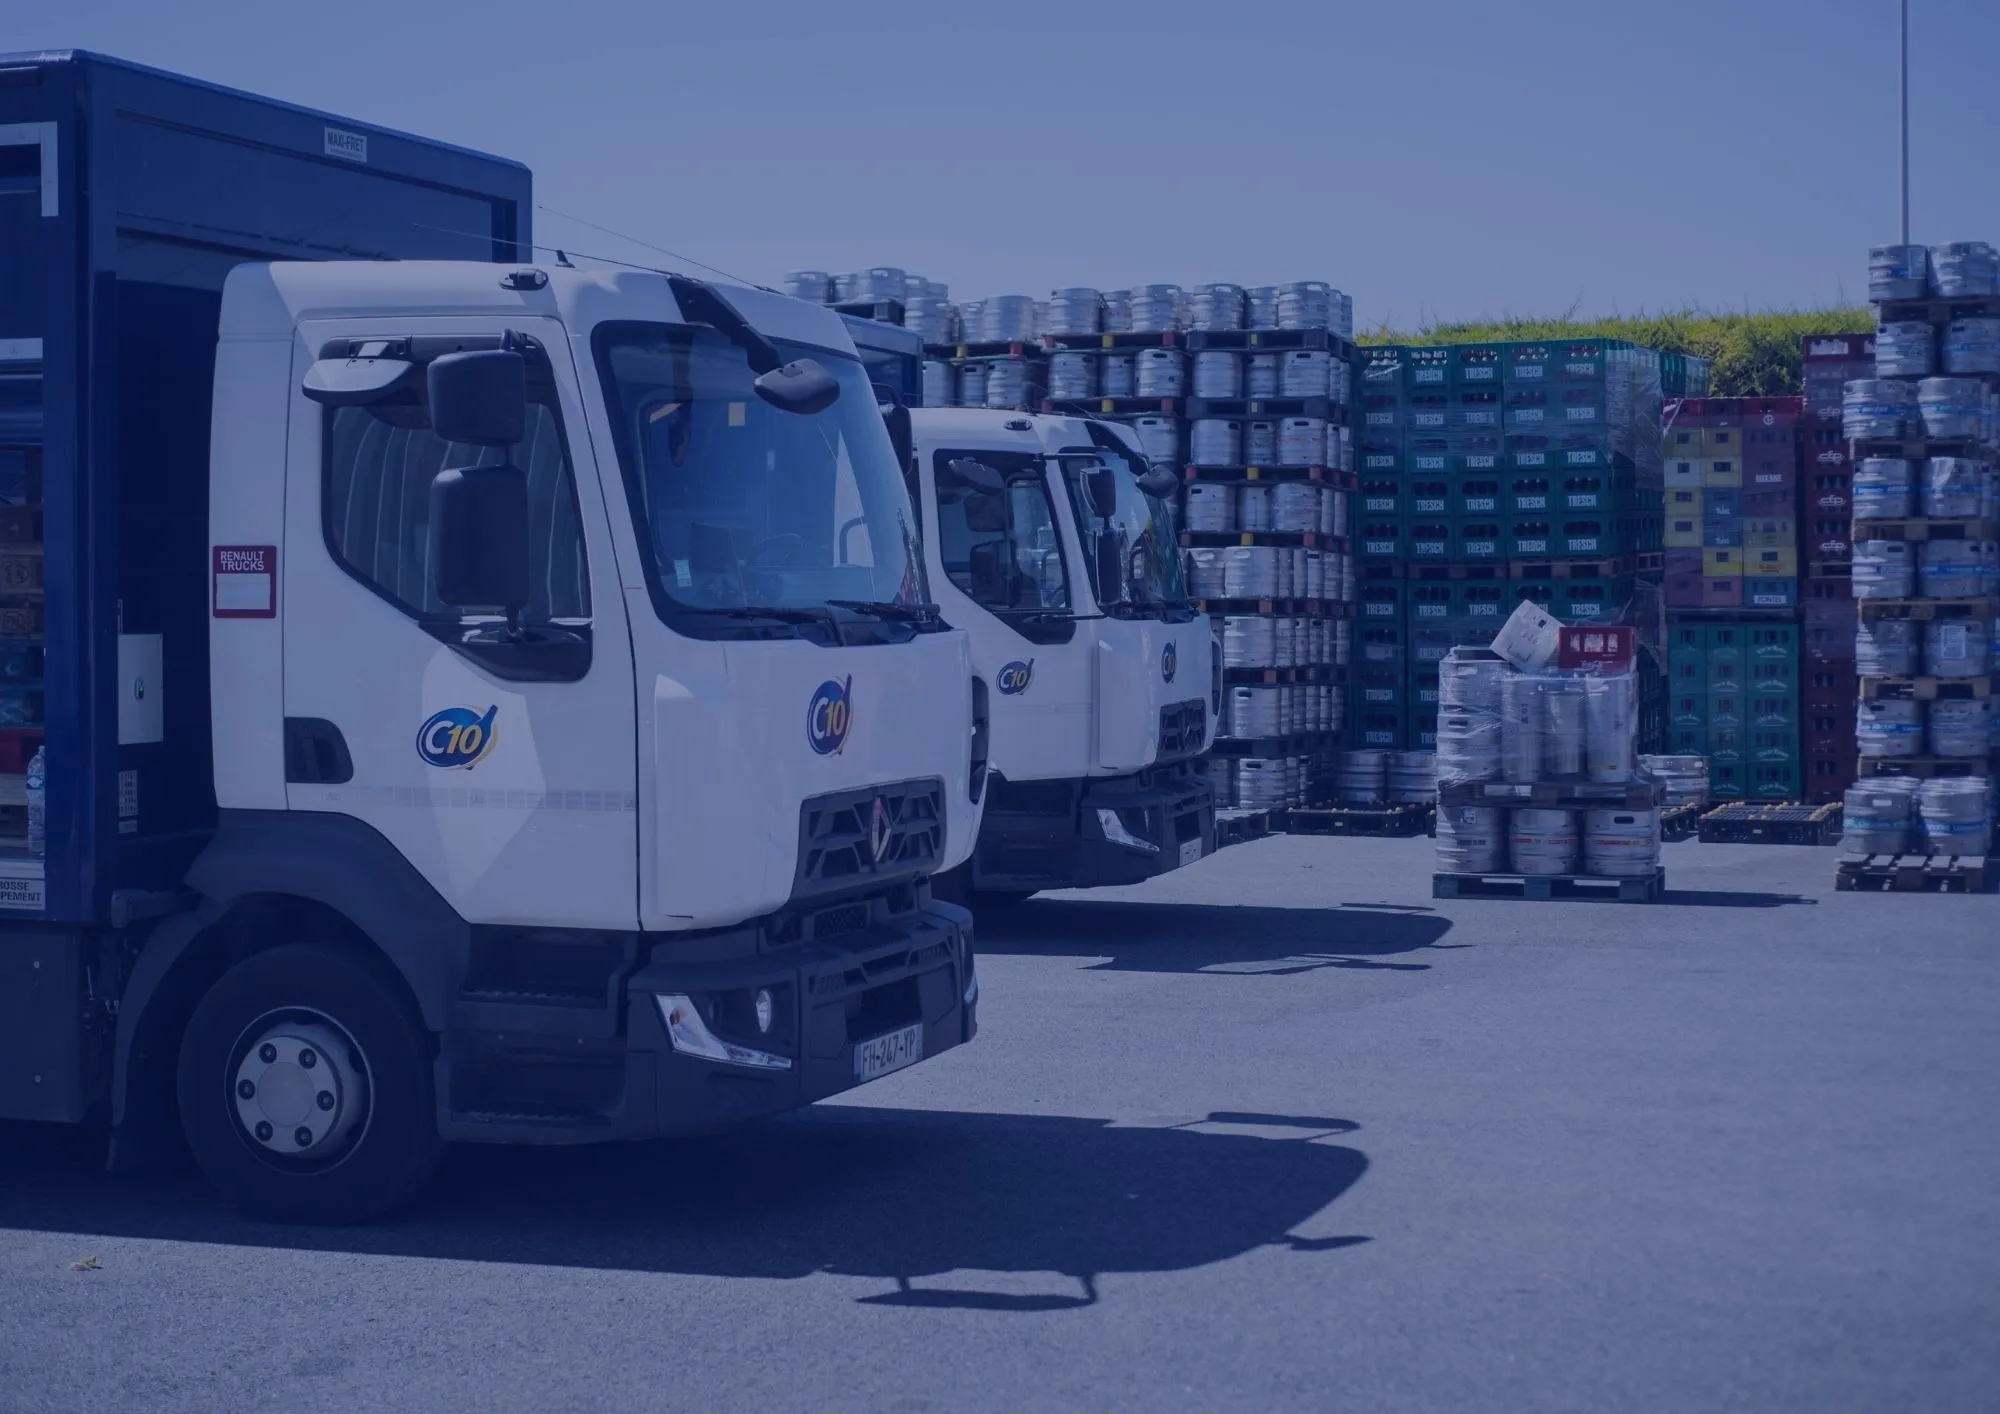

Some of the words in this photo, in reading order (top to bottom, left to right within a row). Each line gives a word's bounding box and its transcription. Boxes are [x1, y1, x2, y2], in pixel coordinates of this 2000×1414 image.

[328, 131, 364, 152] MAXI-FRET
[1465, 367, 1494, 379] TRESCH
[1515, 366, 1543, 378] TRESCH
[1565, 363, 1594, 375] TRESCH
[1416, 414, 1444, 425] TRESCH
[1515, 409, 1543, 422] TRESCH
[1566, 407, 1595, 420] TRESCH
[1366, 455, 1394, 467] TRESCH
[1416, 457, 1444, 468] TRESCH
[1466, 456, 1494, 468] TRESCH
[1516, 452, 1545, 465] TRESCH
[1567, 451, 1596, 463] TRESCH
[1366, 499, 1394, 510] TRESCH
[1416, 500, 1444, 511] TRESCH
[1466, 499, 1494, 510] TRESCH
[1517, 496, 1546, 509] TRESCH
[1568, 495, 1597, 507] TRESCH
[1366, 542, 1394, 553] TRESCH
[1416, 543, 1444, 554] TRESCH
[1568, 539, 1597, 551] TRESCH
[220, 551, 264, 561] RENAULT
[221, 561, 264, 571] TRUCKS
[1366, 604, 1393, 615] TRESCH
[1418, 605, 1446, 617] TRESCH
[1468, 604, 1498, 616] TRESCH
[1571, 604, 1600, 615] TRESCH
[1000, 669, 1027, 688] C10
[1420, 690, 1438, 701] TRES
[812, 696, 846, 740] C10
[425, 720, 482, 754] C10
[1420, 732, 1437, 744] TRES
[863, 1028, 916, 1076] FH-247-YP
